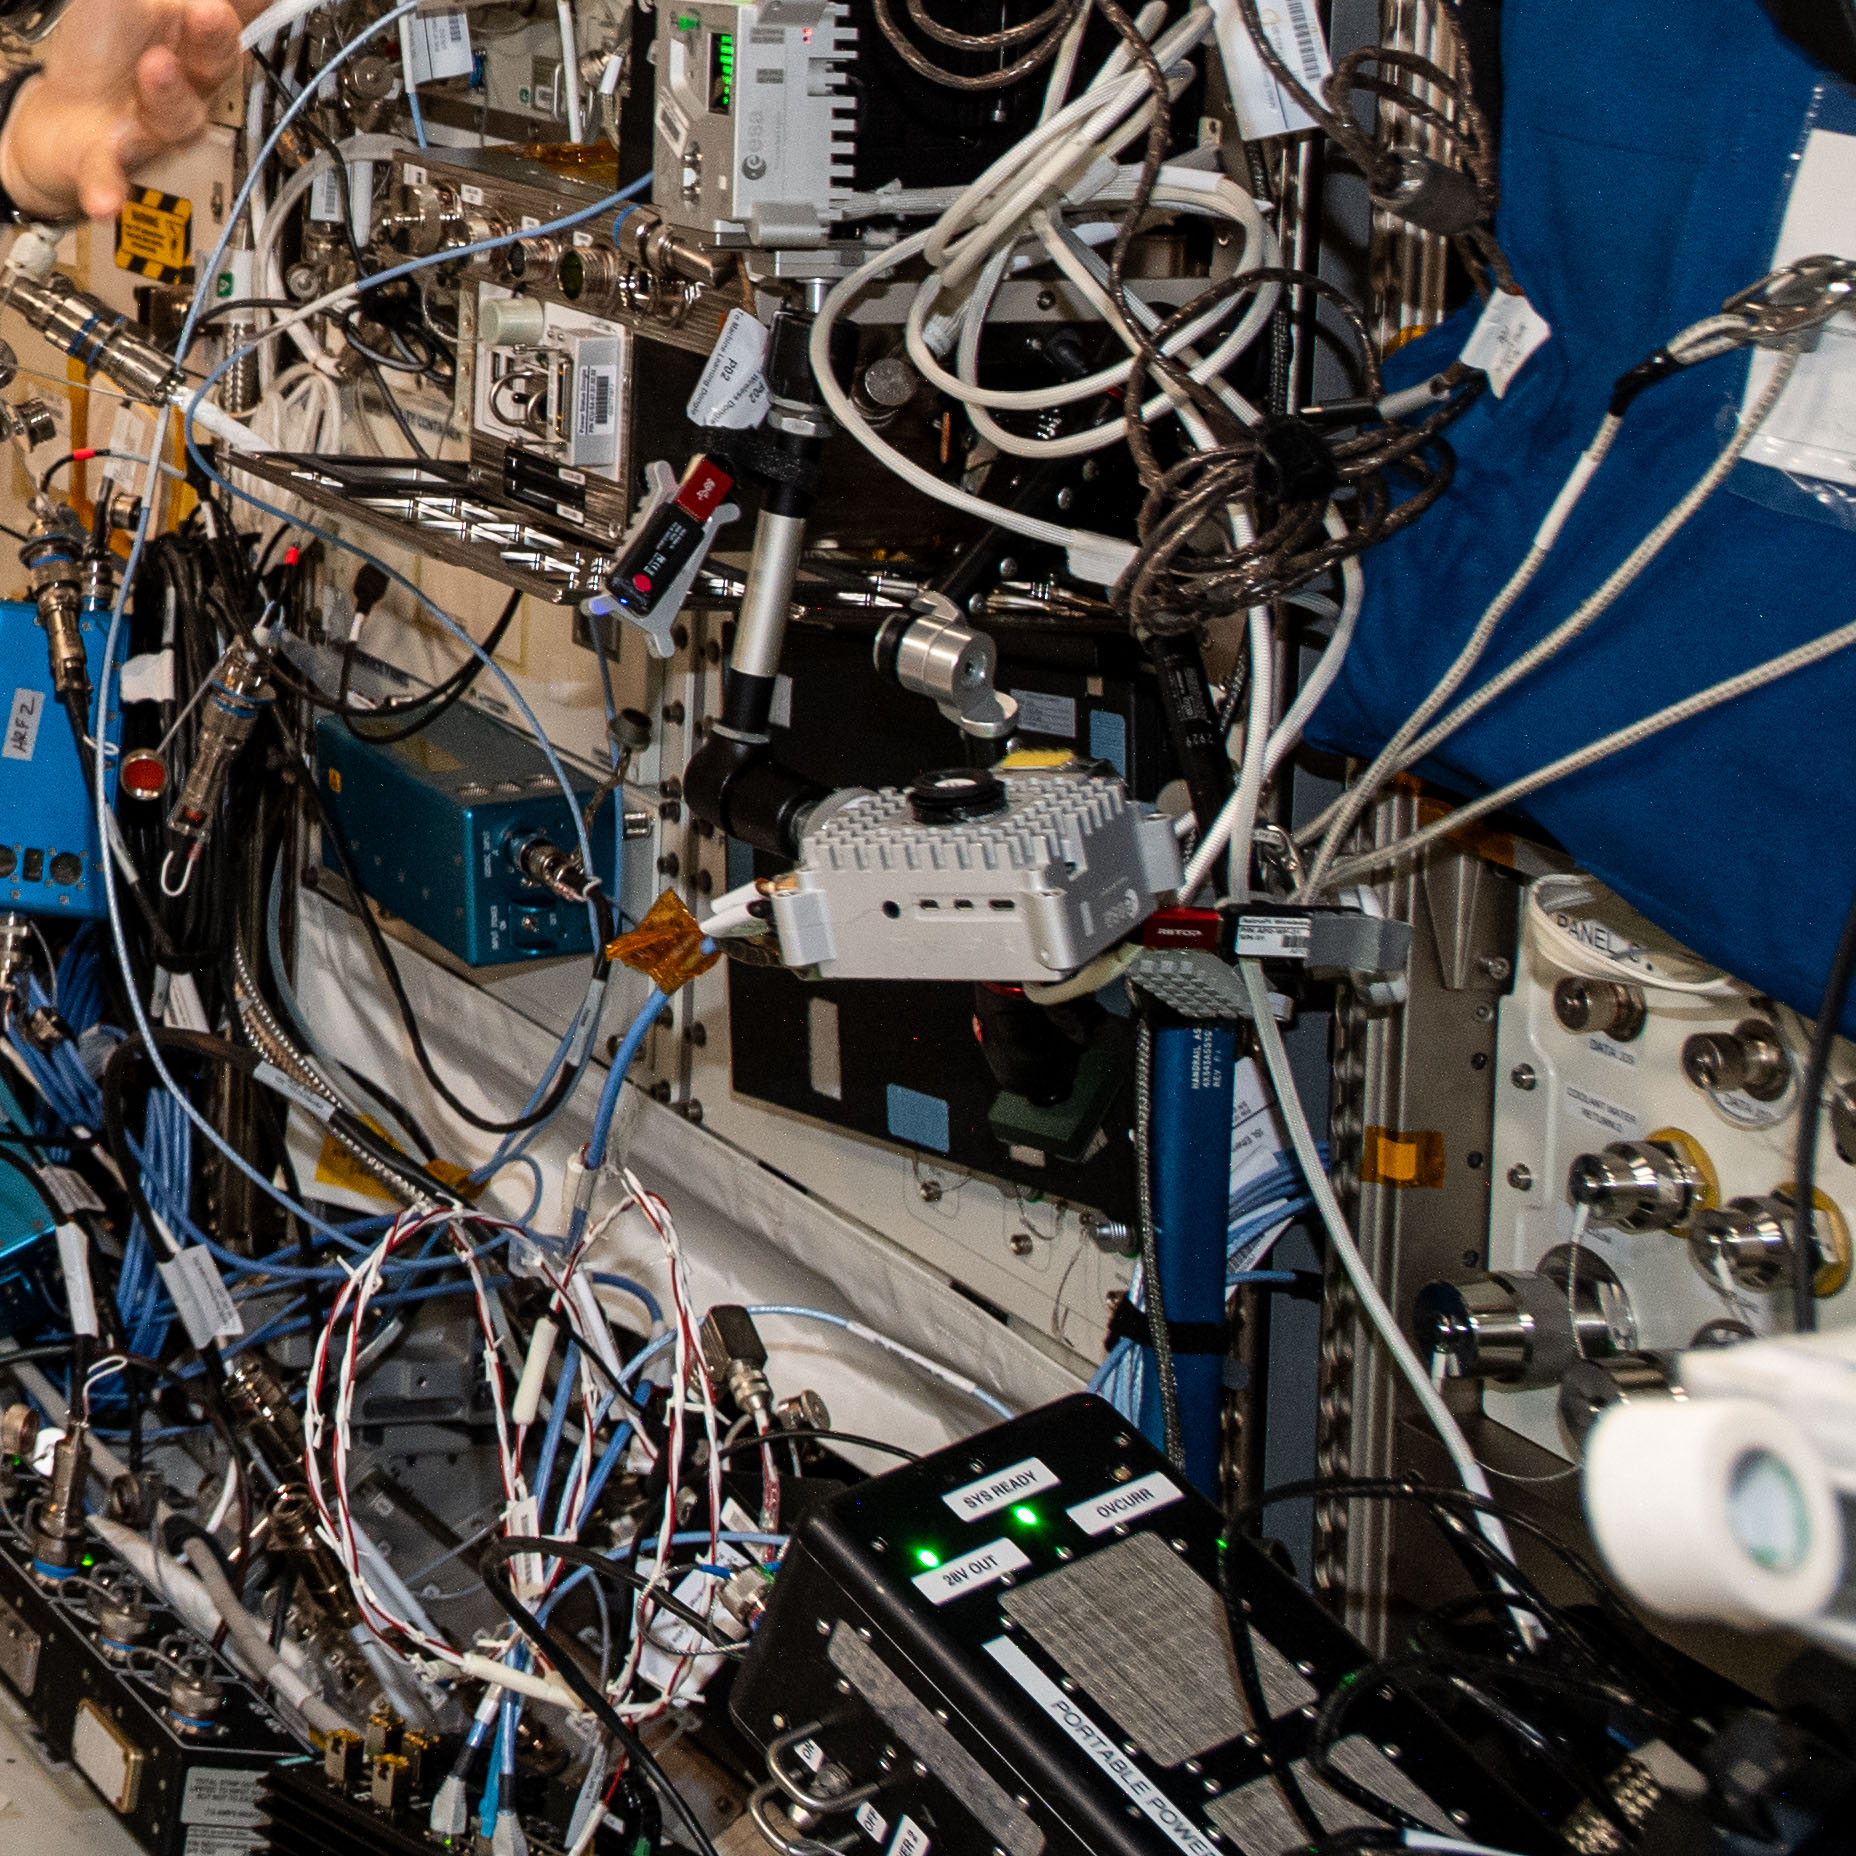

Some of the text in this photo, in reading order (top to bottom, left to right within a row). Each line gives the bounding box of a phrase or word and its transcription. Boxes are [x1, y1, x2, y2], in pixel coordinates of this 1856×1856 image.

[688, 309, 744, 417] To Machine Learning Dongle
[718, 357, 739, 384] P02
[577, 367, 589, 434] Power Status Dongle
[708, 369, 759, 429] Wireless Dongle
[745, 380, 766, 406] P02
[1551, 913, 1617, 953] PANEL
[1191, 1044, 1200, 1088] HANDRAIL
[1588, 1038, 1617, 1054] DATA
[1563, 1086, 1638, 1123] COOLANT WATER
[961, 1465, 1039, 1514] SYS READY
[1094, 1481, 1156, 1524] OVCURR
[940, 1553, 1000, 1590] 28V OUT
[1049, 1688, 1150, 1806] PORTABLE
[858, 1807, 883, 1832] OFF
